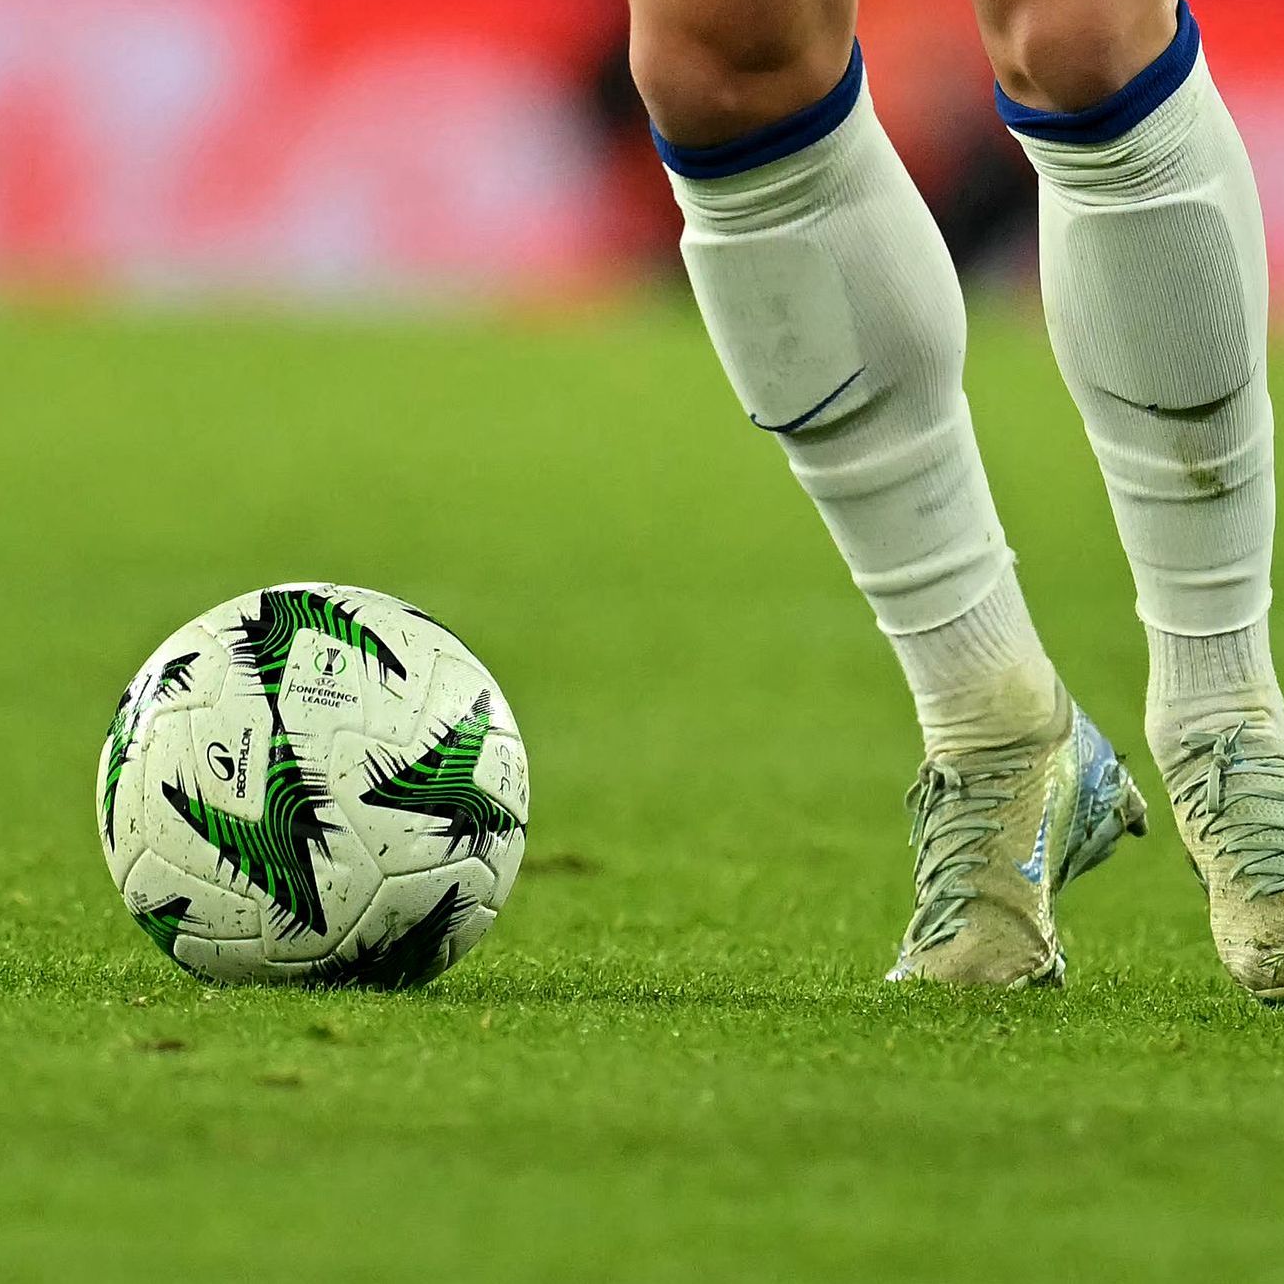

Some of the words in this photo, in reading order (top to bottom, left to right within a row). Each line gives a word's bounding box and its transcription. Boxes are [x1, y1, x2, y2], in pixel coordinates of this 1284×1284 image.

[289, 684, 358, 704] CONFERENCE
[302, 695, 341, 708] LEAGUE
[236, 727, 253, 798] DECATHLON
